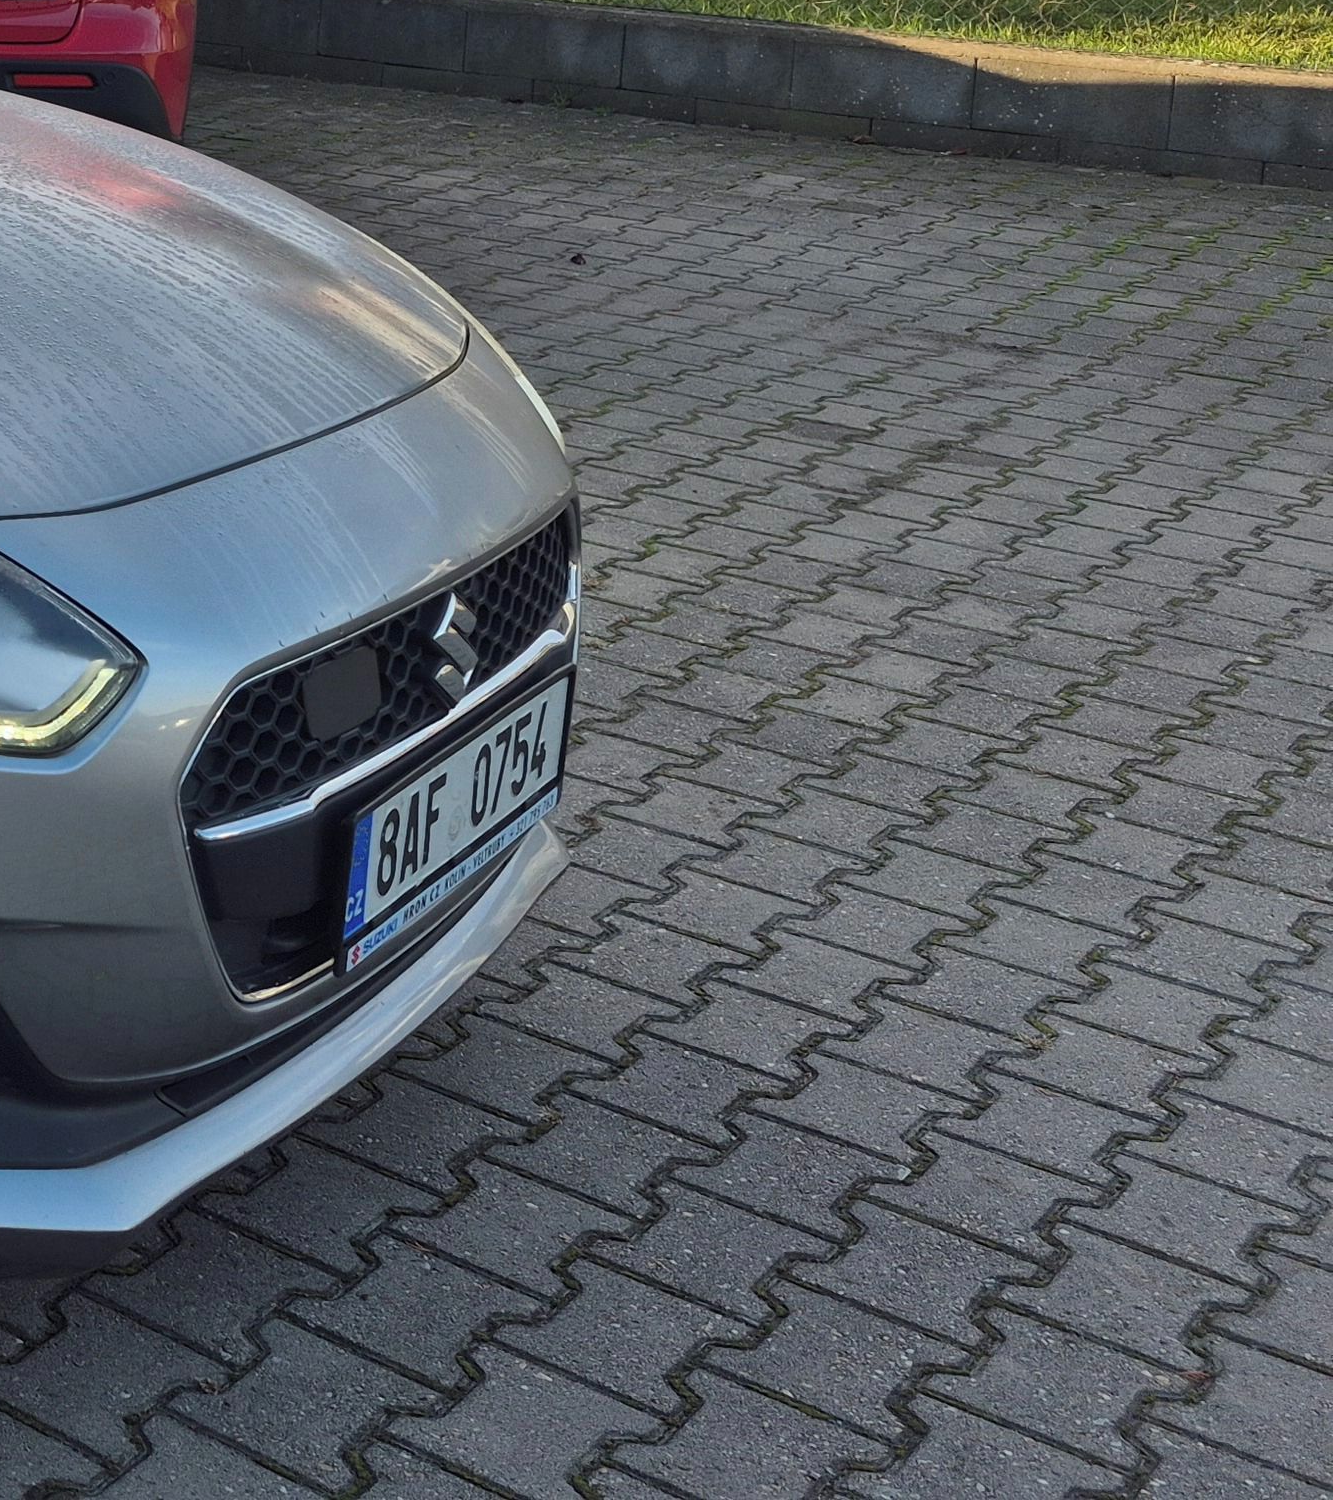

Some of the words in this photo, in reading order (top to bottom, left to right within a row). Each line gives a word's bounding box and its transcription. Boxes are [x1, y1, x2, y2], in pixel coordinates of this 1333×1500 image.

[376, 772, 447, 897] 8AF
[470, 701, 547, 827] 0754
[345, 888, 364, 922] CZ
[362, 917, 398, 954] SUZUKI
[402, 894, 427, 924] HRON
[429, 884, 440, 902] CZ
[473, 833, 506, 869] VELTRUBY
